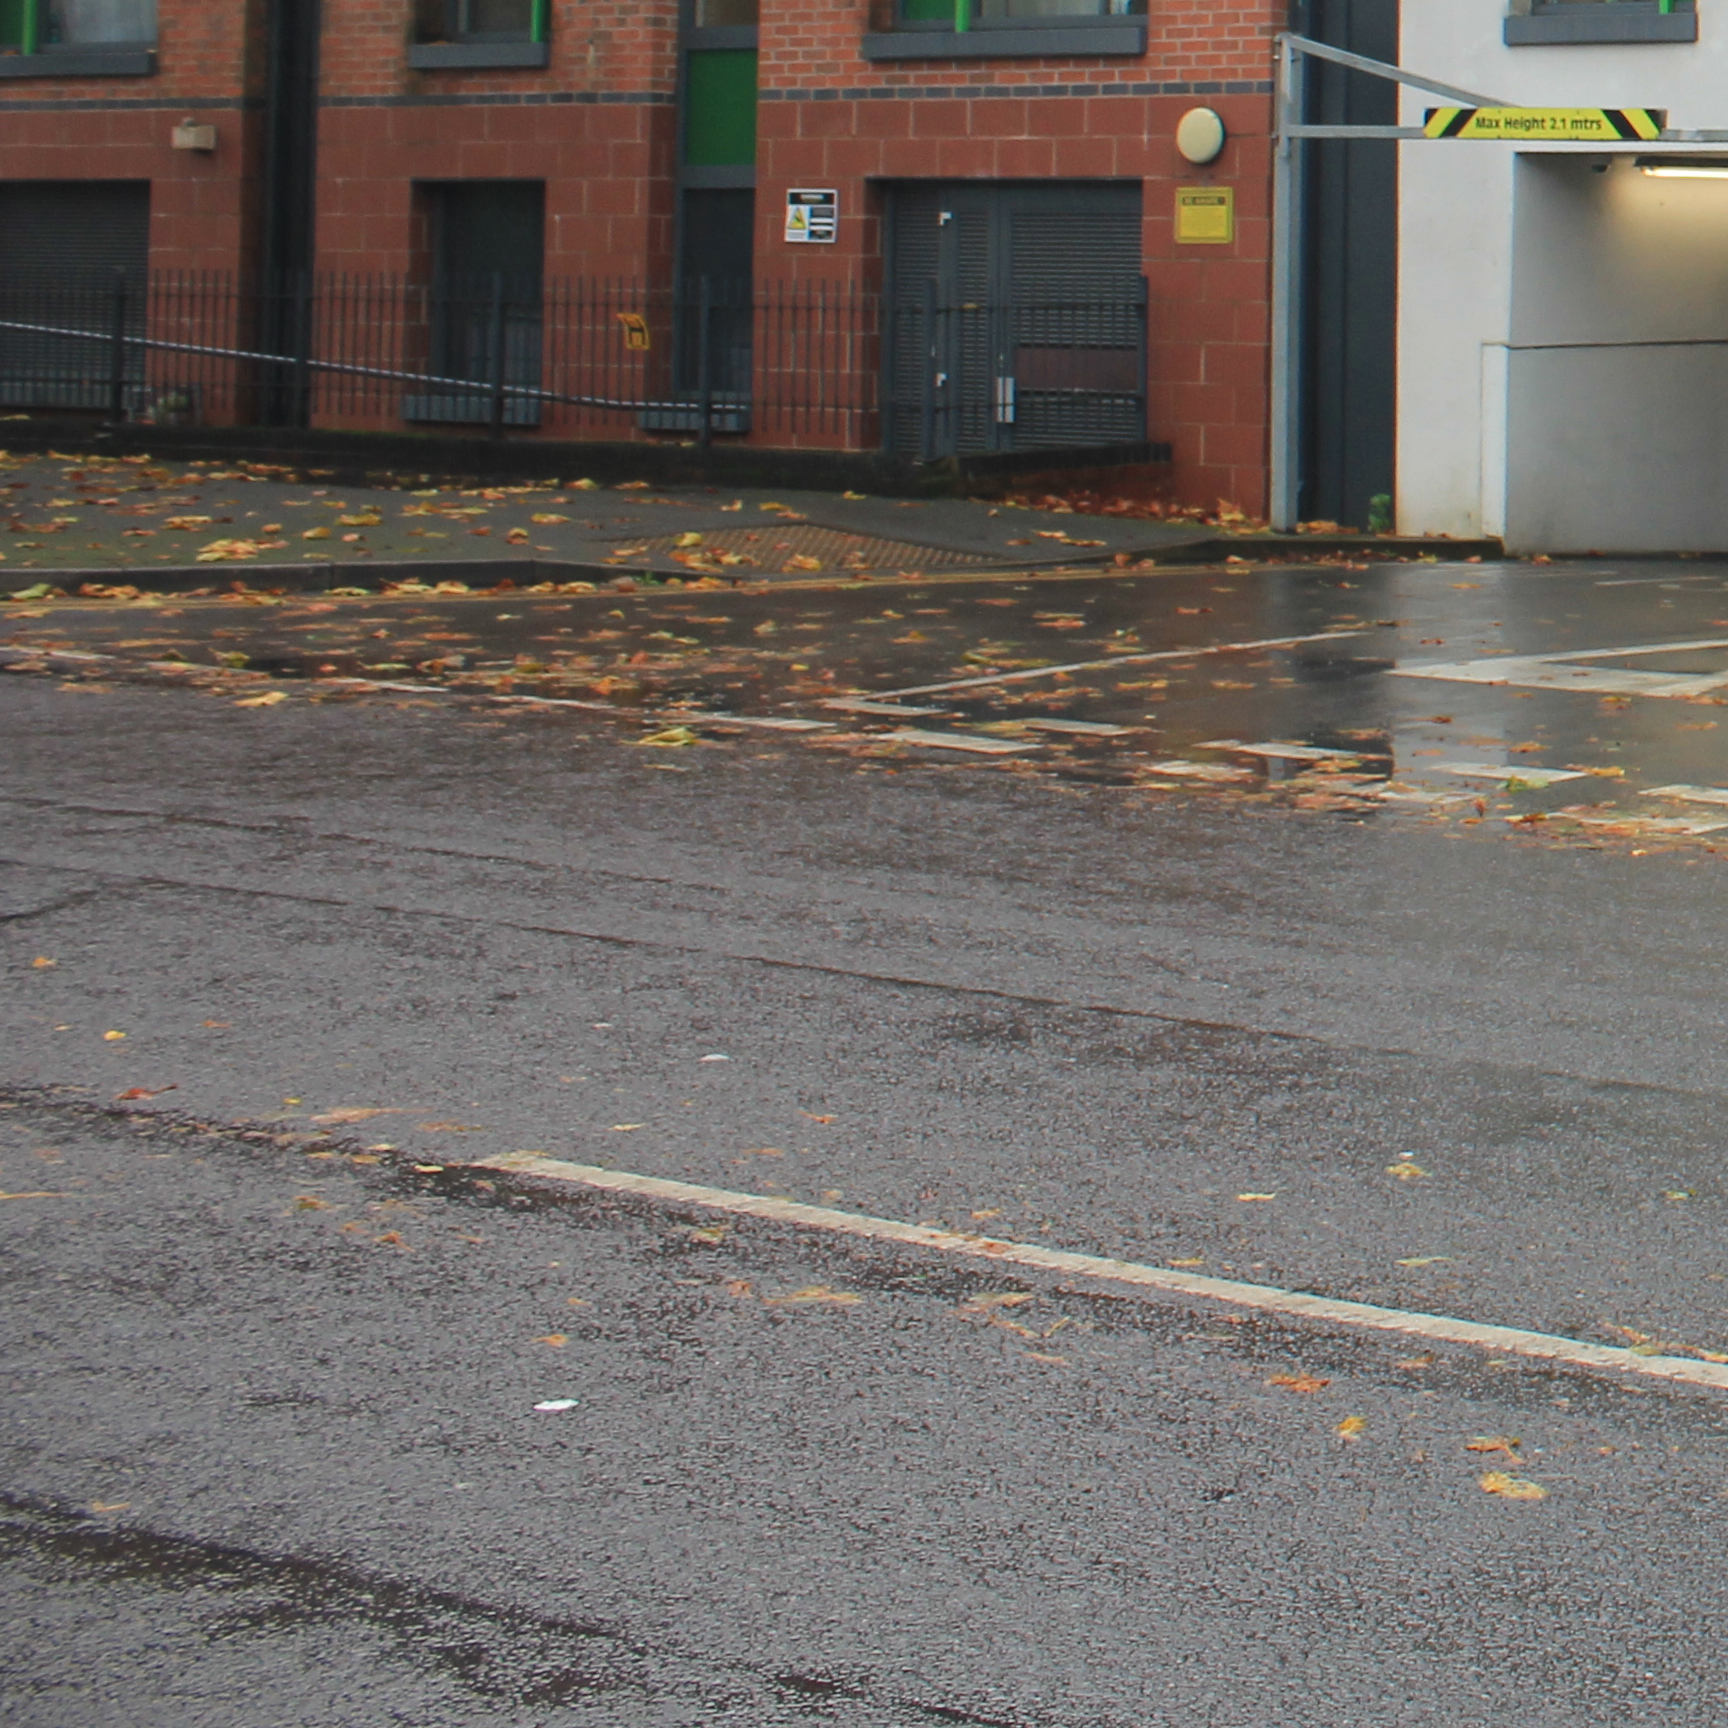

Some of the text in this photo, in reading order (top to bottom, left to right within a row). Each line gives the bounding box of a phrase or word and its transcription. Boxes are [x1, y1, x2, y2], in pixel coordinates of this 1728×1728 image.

[1475, 117, 1602, 132] Max Height 2.1 mtrs
